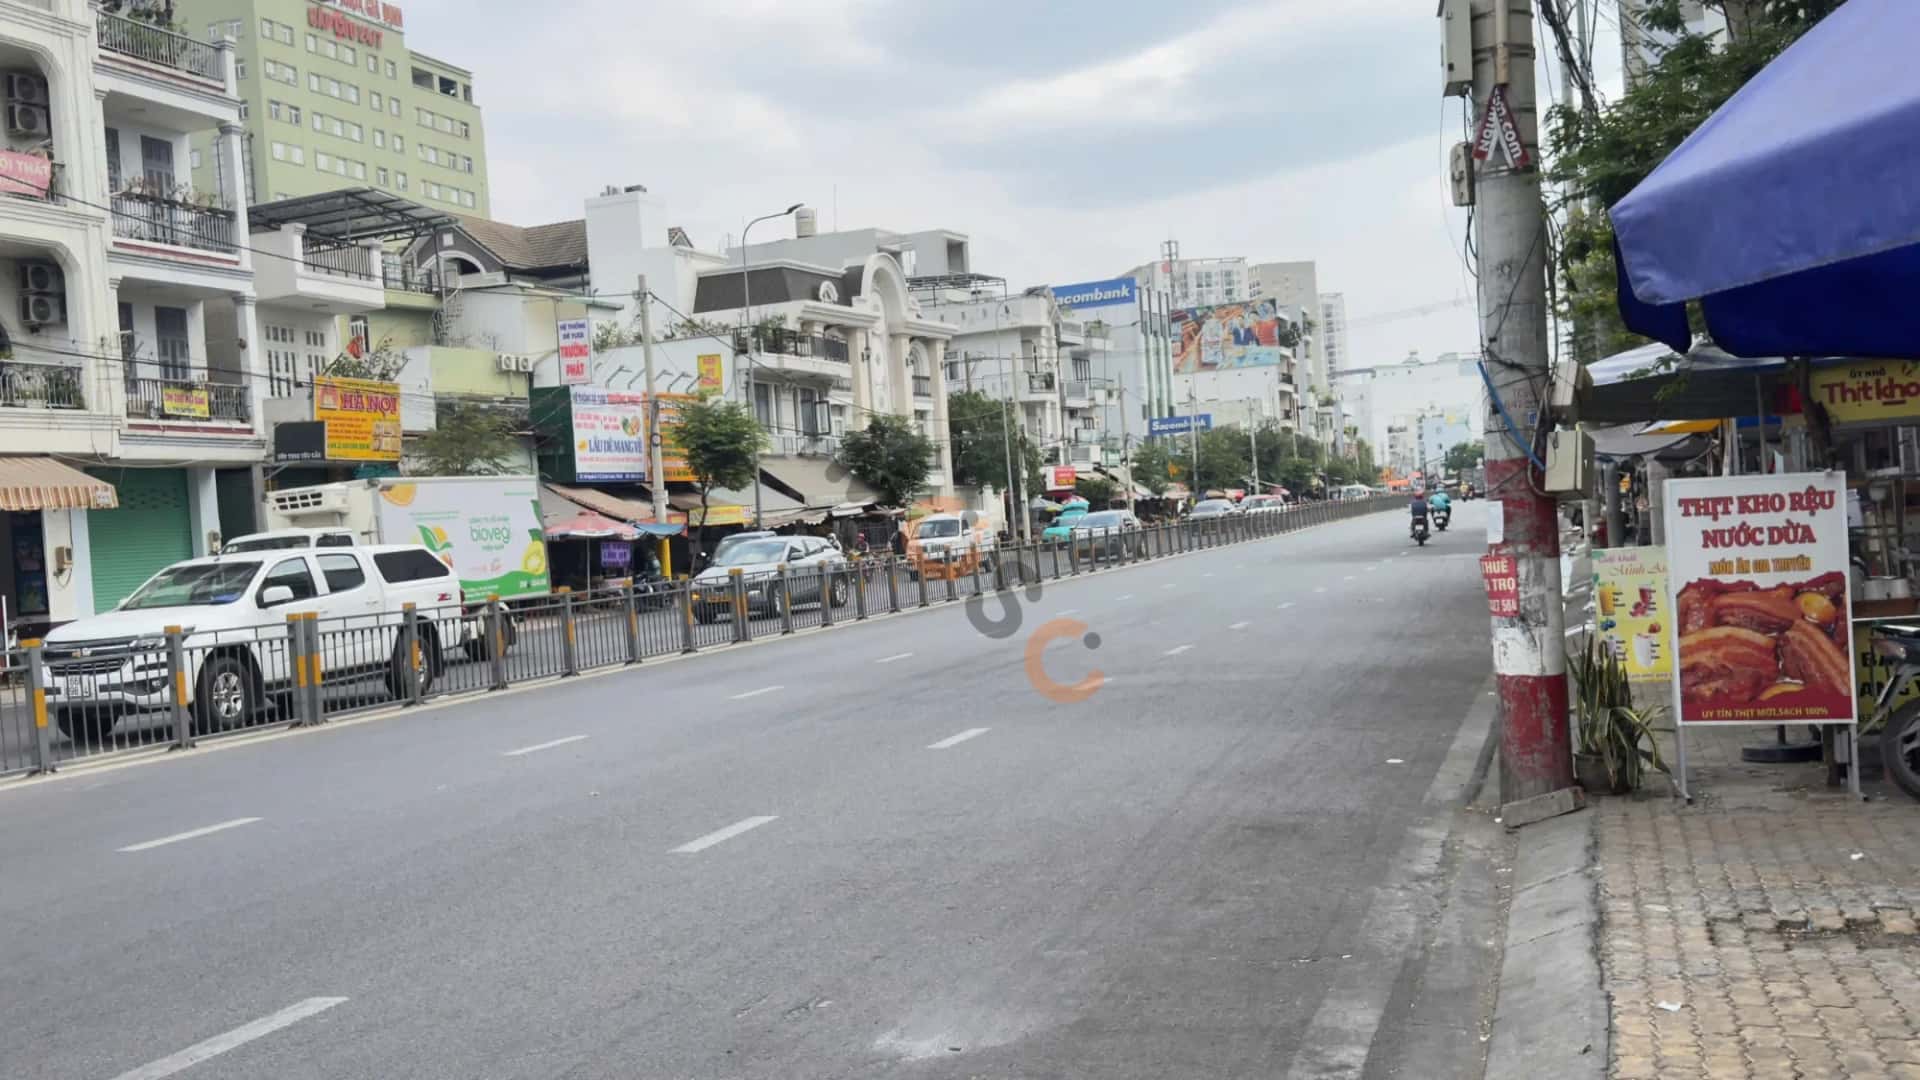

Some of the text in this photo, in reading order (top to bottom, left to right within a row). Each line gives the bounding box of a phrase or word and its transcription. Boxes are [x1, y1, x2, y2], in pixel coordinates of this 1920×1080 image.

[1056, 284, 1130, 305] acombank
[1678, 485, 1835, 521] THỊT KHO RỆU
[1702, 519, 1816, 548] NƯỚC DỪA
